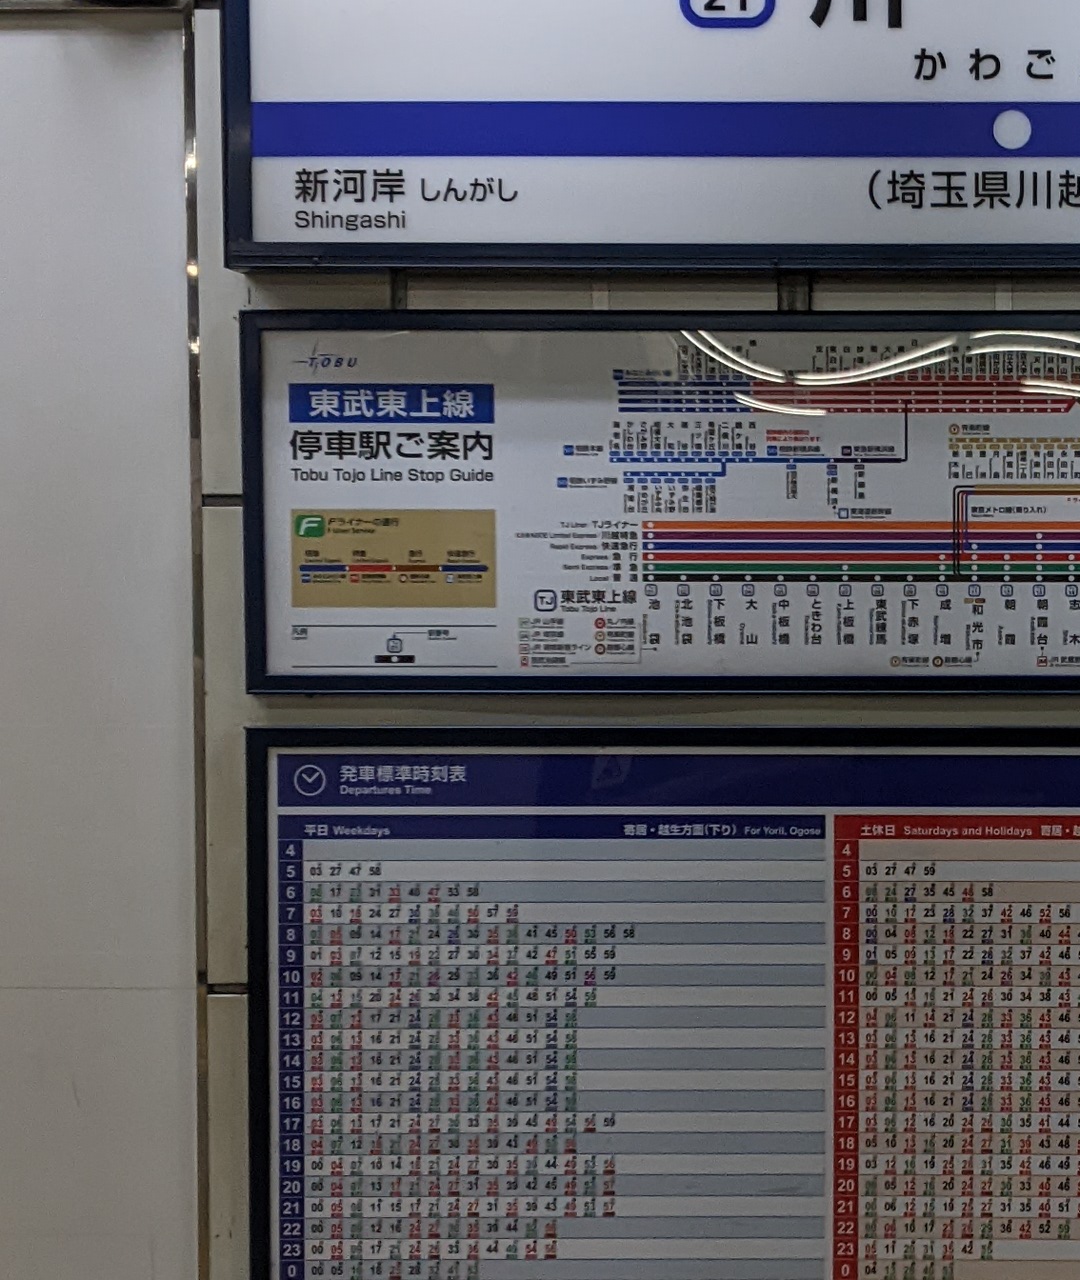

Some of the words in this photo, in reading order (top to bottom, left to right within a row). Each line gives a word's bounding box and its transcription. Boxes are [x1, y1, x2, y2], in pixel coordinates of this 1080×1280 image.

[294, 168, 406, 204] 新河岸
[420, 176, 519, 203] しんがし
[294, 209, 407, 231] Shingashi
[306, 357, 358, 369] TOBU
[308, 389, 475, 418] 東武東上線
[289, 430, 494, 461] 停車駅ご案内
[291, 469, 328, 482] Tobu
[333, 469, 366, 483] Tojo
[370, 469, 403, 482] Line
[409, 468, 445, 483] Stop
[450, 468, 494, 482] Guide
[539, 592, 554, 605] TJ
[561, 590, 637, 605] 東武東上線
[746, 599, 758, 646] 大山
[972, 604, 984, 651] 和光市
[1068, 599, 1080, 646] 志木
[339, 765, 467, 783] 発車標準時刻表
[340, 785, 402, 795] Departures
[405, 785, 433, 795] Time
[304, 824, 329, 836] 平日
[333, 824, 391, 838] Weekdays
[744, 826, 761, 835] For
[861, 824, 896, 836] 土休日
[903, 824, 959, 838] Saturdays
[962, 825, 981, 836] and
[985, 824, 1032, 838] Holidays
[286, 844, 295, 856] 4
[842, 844, 851, 856] 4
[286, 866, 295, 878] 5
[842, 865, 851, 877] 5
[286, 887, 295, 899] 6
[842, 886, 851, 898] 6
[286, 908, 295, 920] 7
[842, 907, 851, 919] 7
[286, 929, 295, 941] 8
[842, 928, 851, 940] 8
[286, 950, 295, 962] 9
[283, 971, 300, 983] 10
[283, 992, 300, 1004] 11
[283, 1013, 300, 1025] 12
[283, 1034, 300, 1046] 13
[283, 1055, 300, 1067] 14
[283, 1076, 300, 1088] 15
[283, 1097, 300, 1109] 16
[283, 1118, 300, 1130] 17
[283, 1139, 300, 1151] 18
[283, 1160, 300, 1172] 19
[283, 1181, 300, 1193] 20
[284, 1202, 300, 1214] 21
[284, 1223, 301, 1235] 22
[284, 1244, 301, 1256] 23
[288, 1266, 296, 1278] 0
